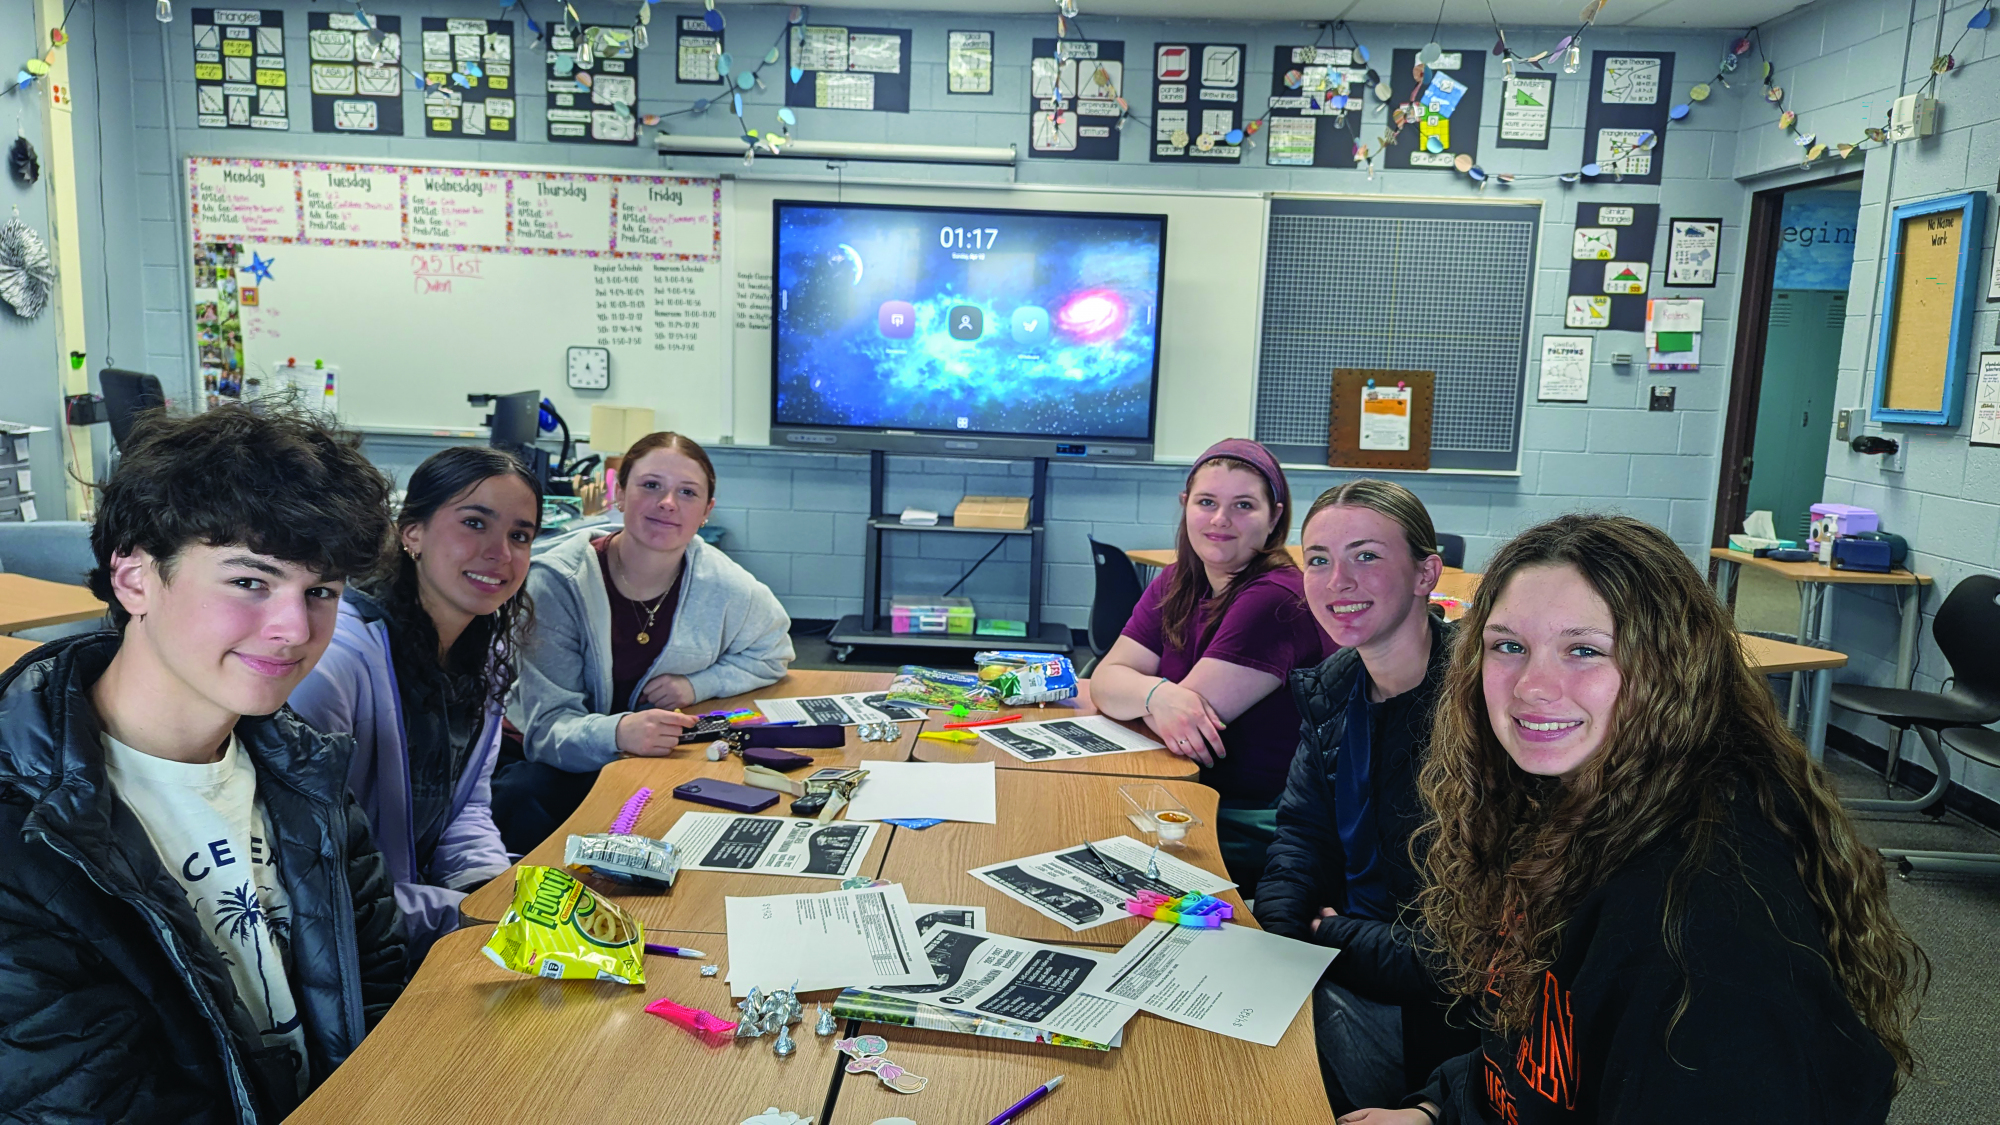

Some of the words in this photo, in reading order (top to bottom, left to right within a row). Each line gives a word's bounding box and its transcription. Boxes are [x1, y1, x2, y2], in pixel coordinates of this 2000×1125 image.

[223, 169, 265, 188] Monday
[327, 173, 371, 192] Tuesday
[424, 177, 483, 197] Wednesday
[537, 182, 587, 202] Thursday
[649, 187, 682, 206] Friday
[1927, 219, 1935, 230] No
[1936, 217, 1955, 229] Name
[940, 226, 998, 250] 01:17
[1782, 222, 1856, 247] egin
[1931, 234, 1948, 247] Work
[444, 254, 484, 275] Test
[561, 901, 574, 920] Onion
